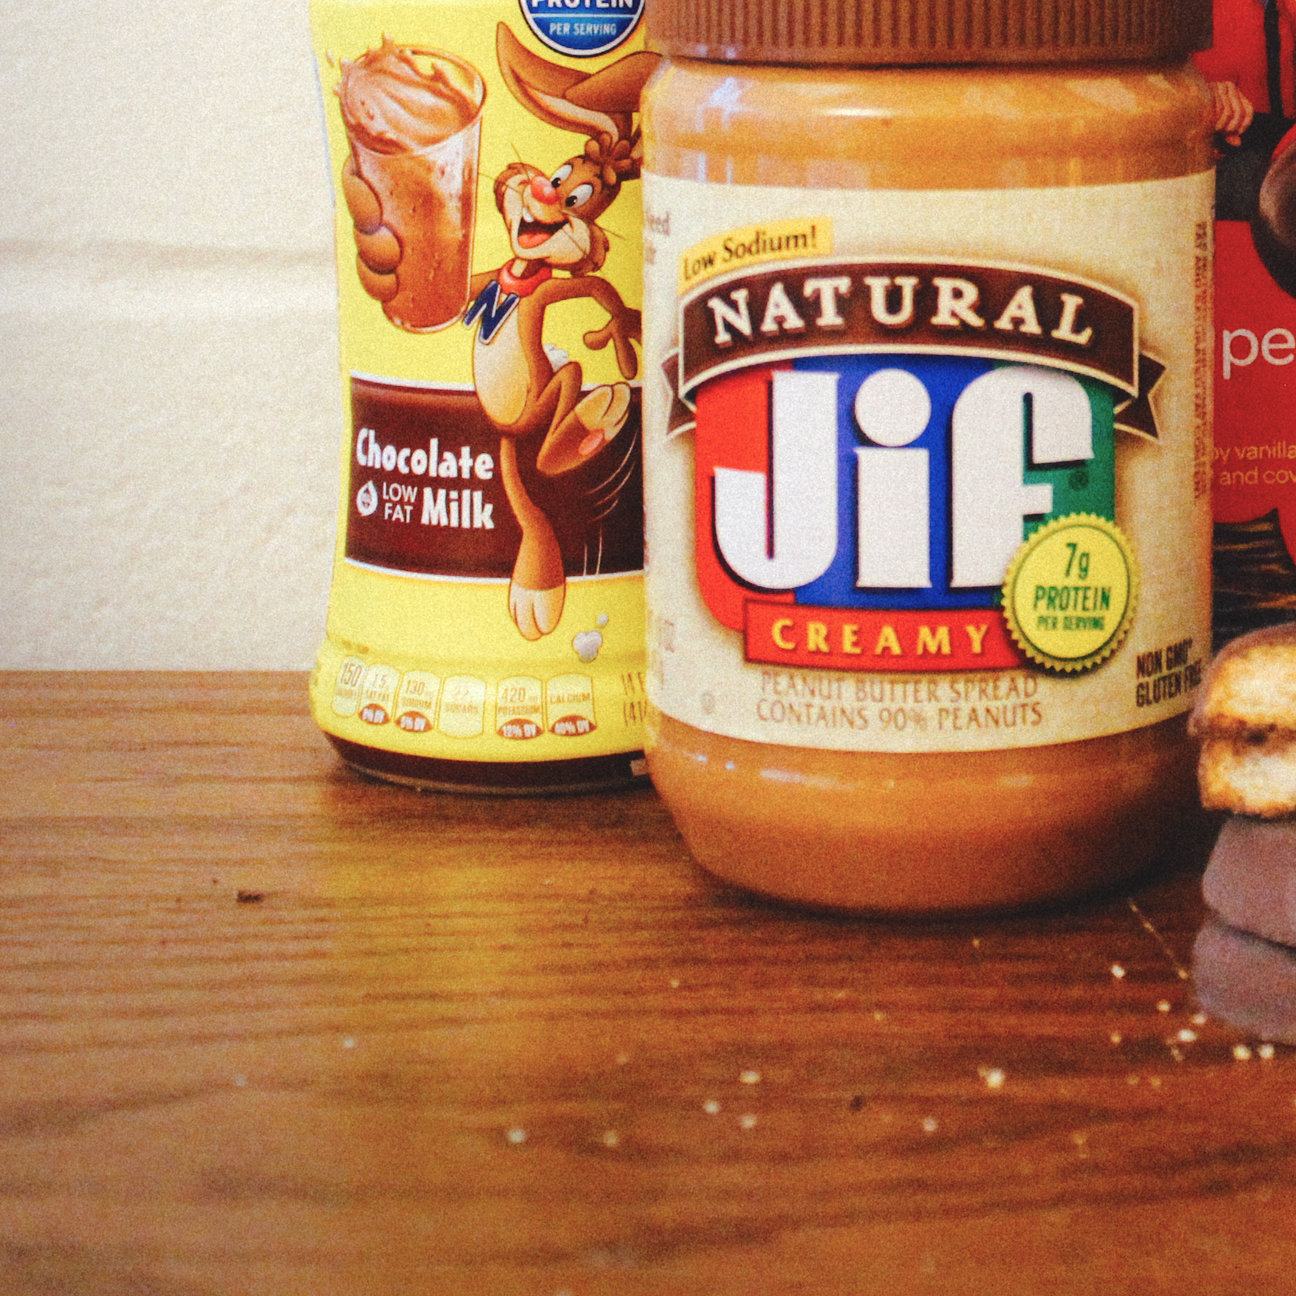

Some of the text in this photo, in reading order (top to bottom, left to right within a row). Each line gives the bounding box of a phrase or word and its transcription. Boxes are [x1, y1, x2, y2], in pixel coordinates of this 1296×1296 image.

[549, 23, 617, 35] PER SERVING
[684, 251, 716, 280] Low
[722, 226, 816, 263] Sodium!
[707, 276, 1092, 345] NATURAL
[356, 428, 495, 480] Chocolate
[713, 366, 1094, 590] Jif
[1220, 466, 1258, 485] and
[382, 482, 417, 503] LOW
[421, 487, 495, 529] Milk
[385, 505, 413, 523] FAT
[1066, 543, 1090, 580] 7g
[1034, 586, 1111, 611] PROTEIN
[771, 619, 988, 654] CREAMY
[1037, 616, 1105, 630] PER SERVING
[1136, 649, 1162, 680] NON
[761, 671, 1038, 704] PEANUT BUTTER SPREAD
[1136, 670, 1181, 707] GLUTEN
[756, 699, 1042, 732] CONTAINS 90% PEANUTS
